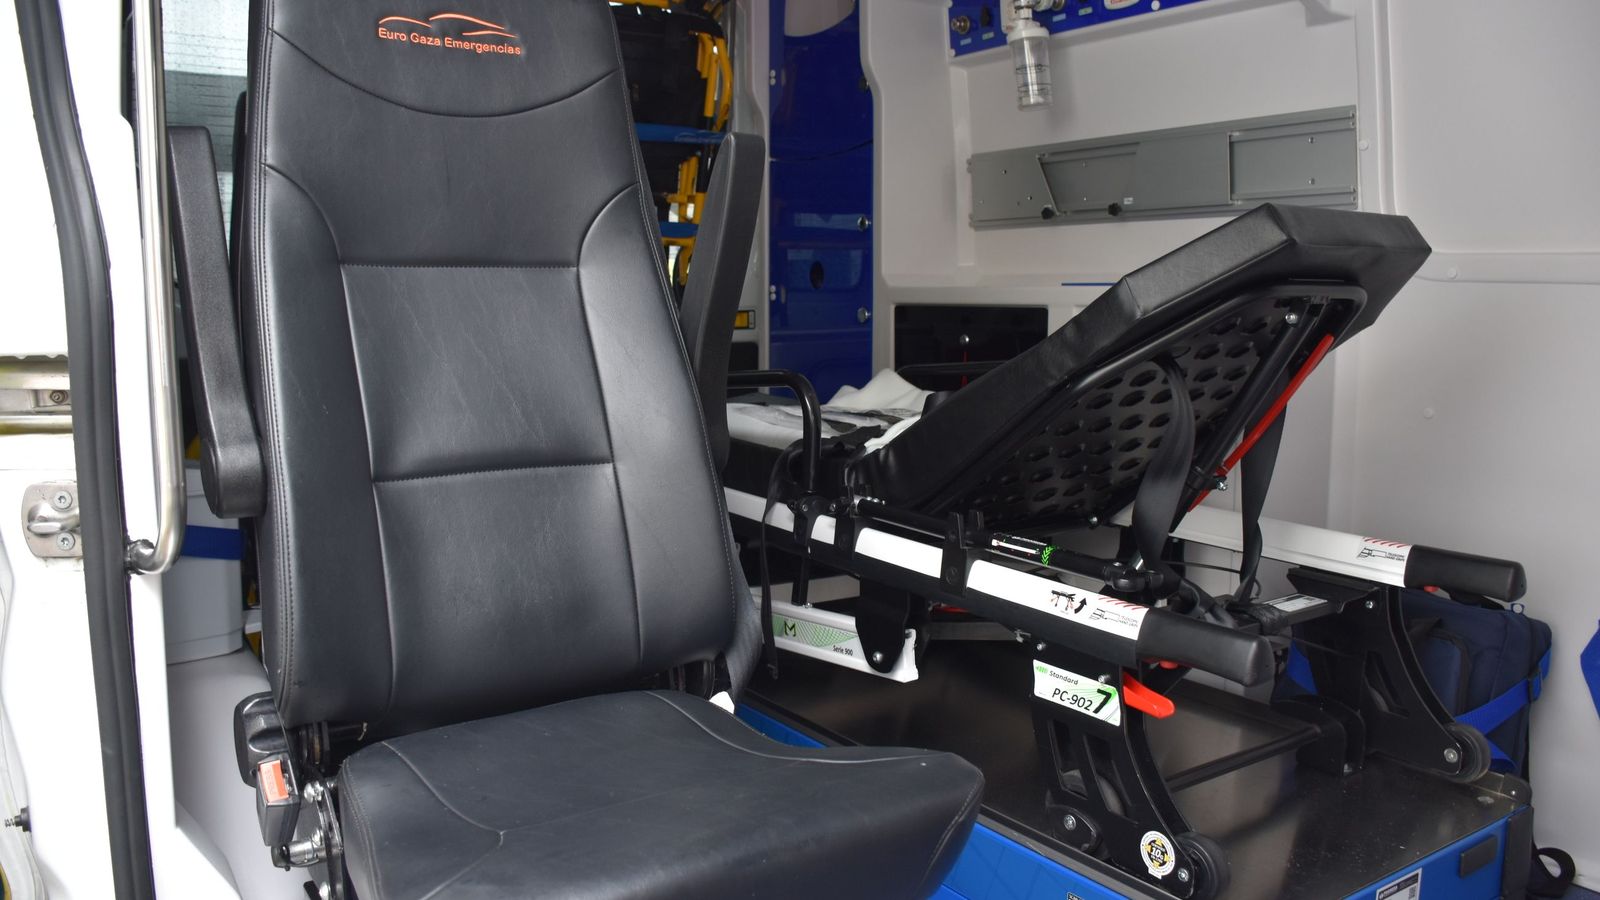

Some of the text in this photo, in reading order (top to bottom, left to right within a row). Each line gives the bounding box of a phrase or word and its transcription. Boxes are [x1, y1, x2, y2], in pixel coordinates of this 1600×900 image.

[378, 27, 521, 55] Euro Gaza Emergencias
[832, 644, 853, 657] Serie 900
[1049, 670, 1079, 685] Standard
[1051, 687, 1112, 714] PC-902 7
